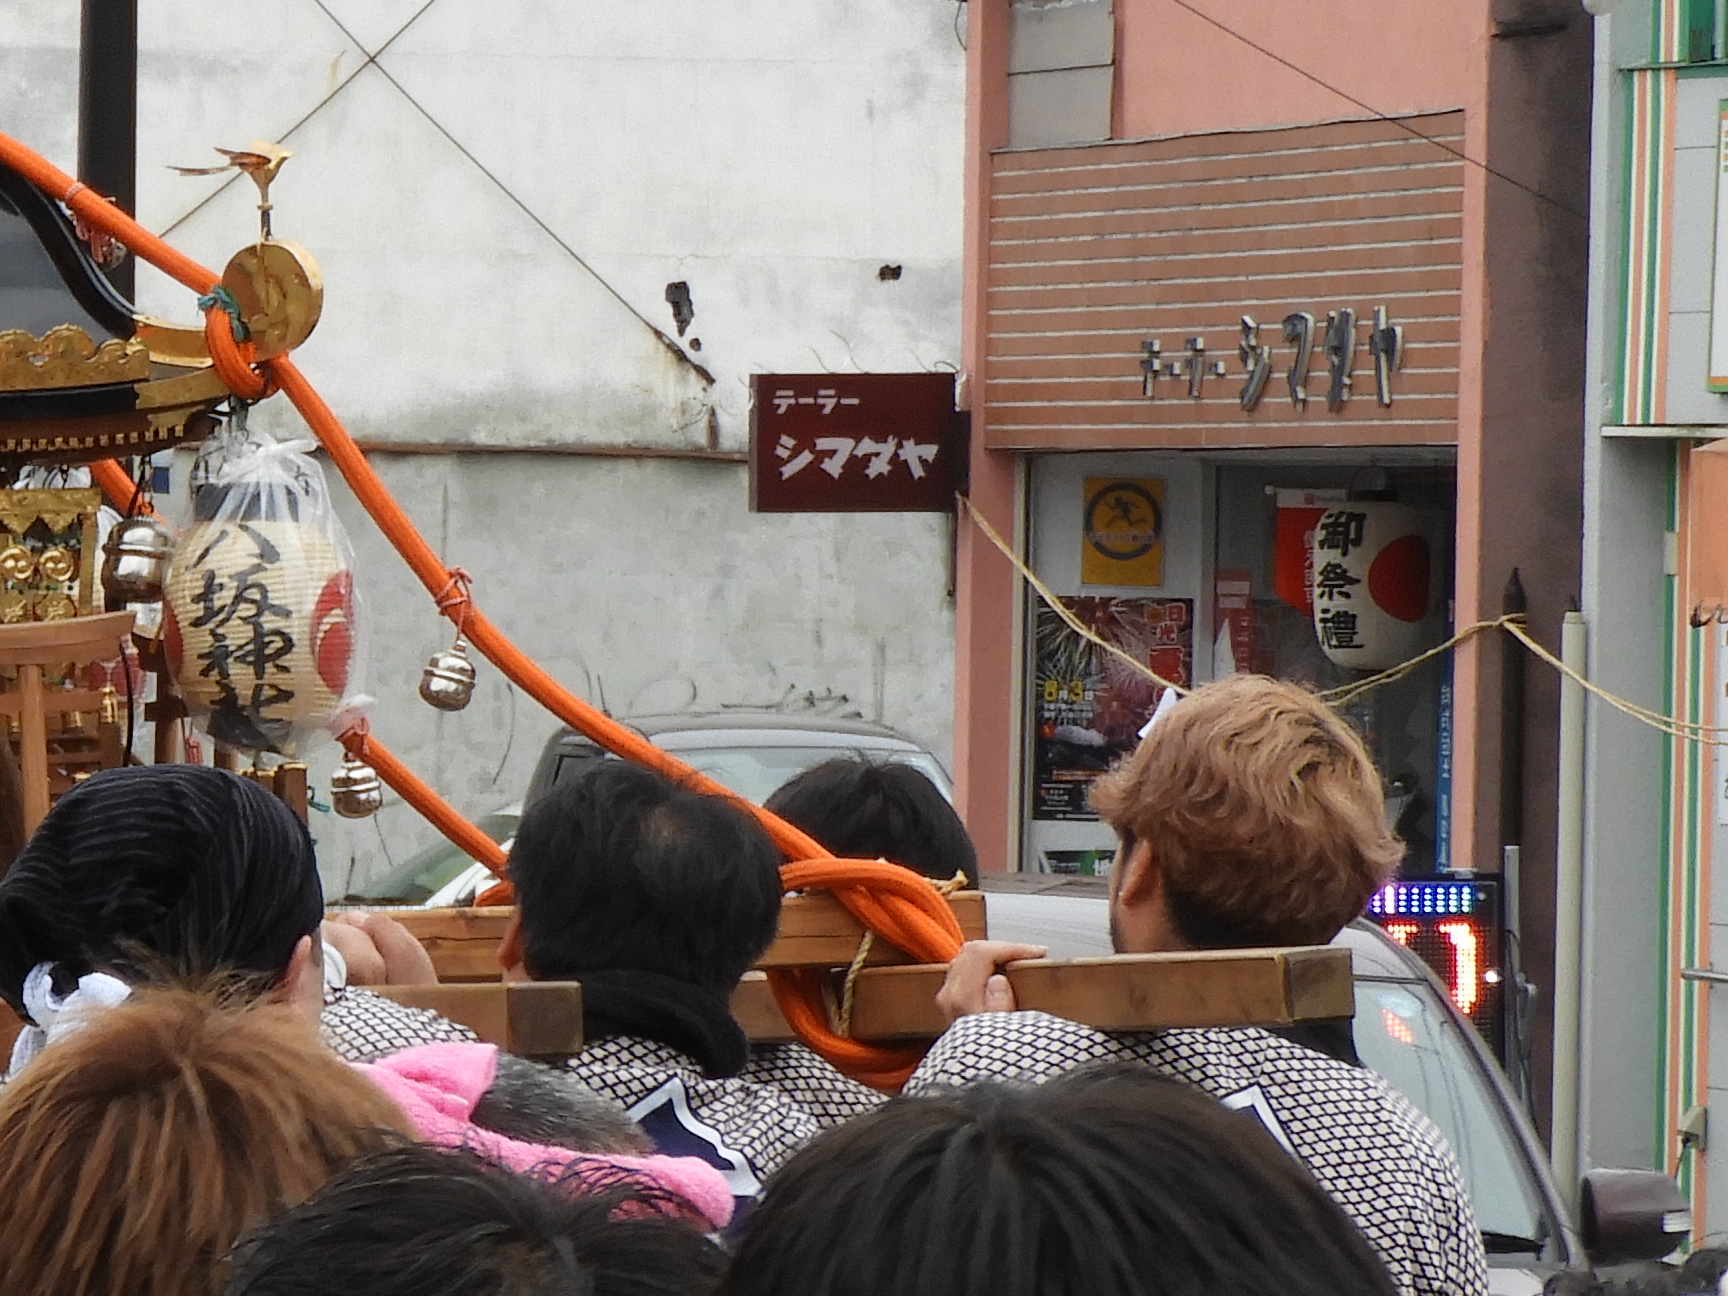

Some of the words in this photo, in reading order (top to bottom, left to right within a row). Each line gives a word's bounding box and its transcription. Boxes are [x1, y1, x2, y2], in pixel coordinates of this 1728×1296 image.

[1141, 305, 1404, 414] テーラーシマダヤ
[772, 389, 860, 415] テーラー
[774, 434, 939, 481] シマダヤ
[186, 522, 295, 724] 八坂神社
